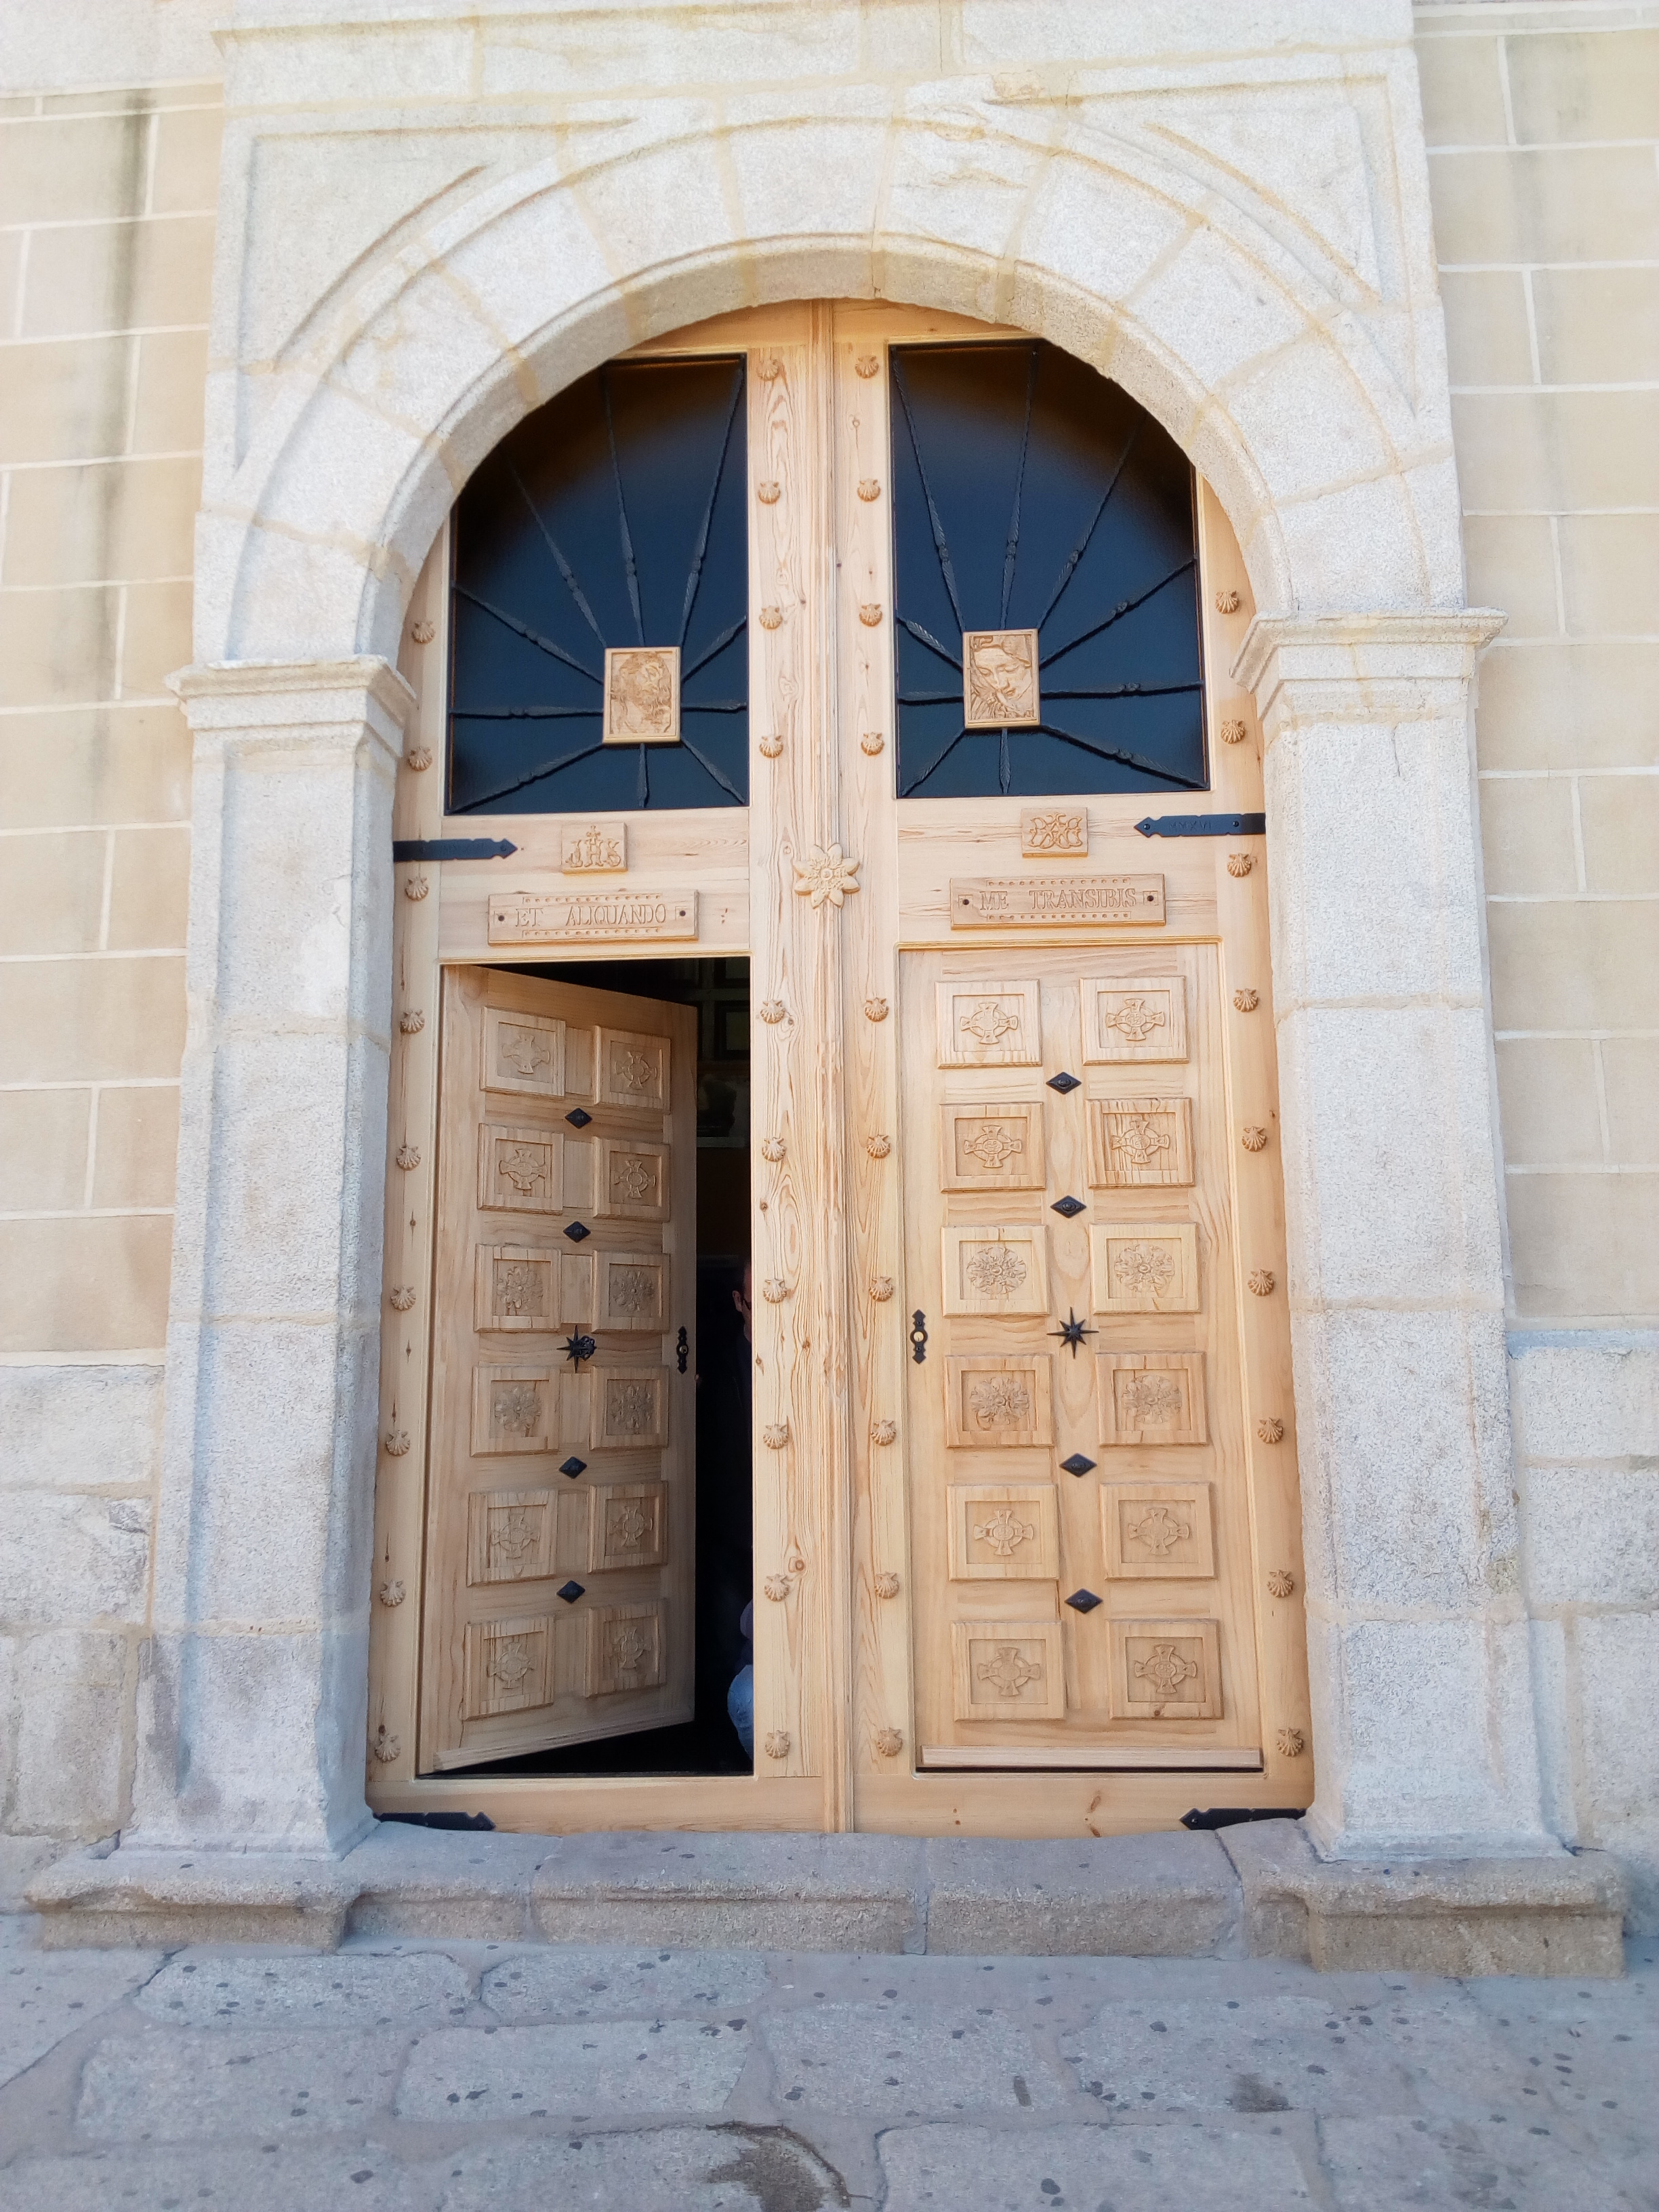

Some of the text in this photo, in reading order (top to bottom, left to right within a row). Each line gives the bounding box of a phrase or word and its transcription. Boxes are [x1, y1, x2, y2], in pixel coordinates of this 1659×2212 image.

[980, 888, 1136, 910] ME TRANSIBIS
[516, 903, 667, 927] ET ALIQUANDO
